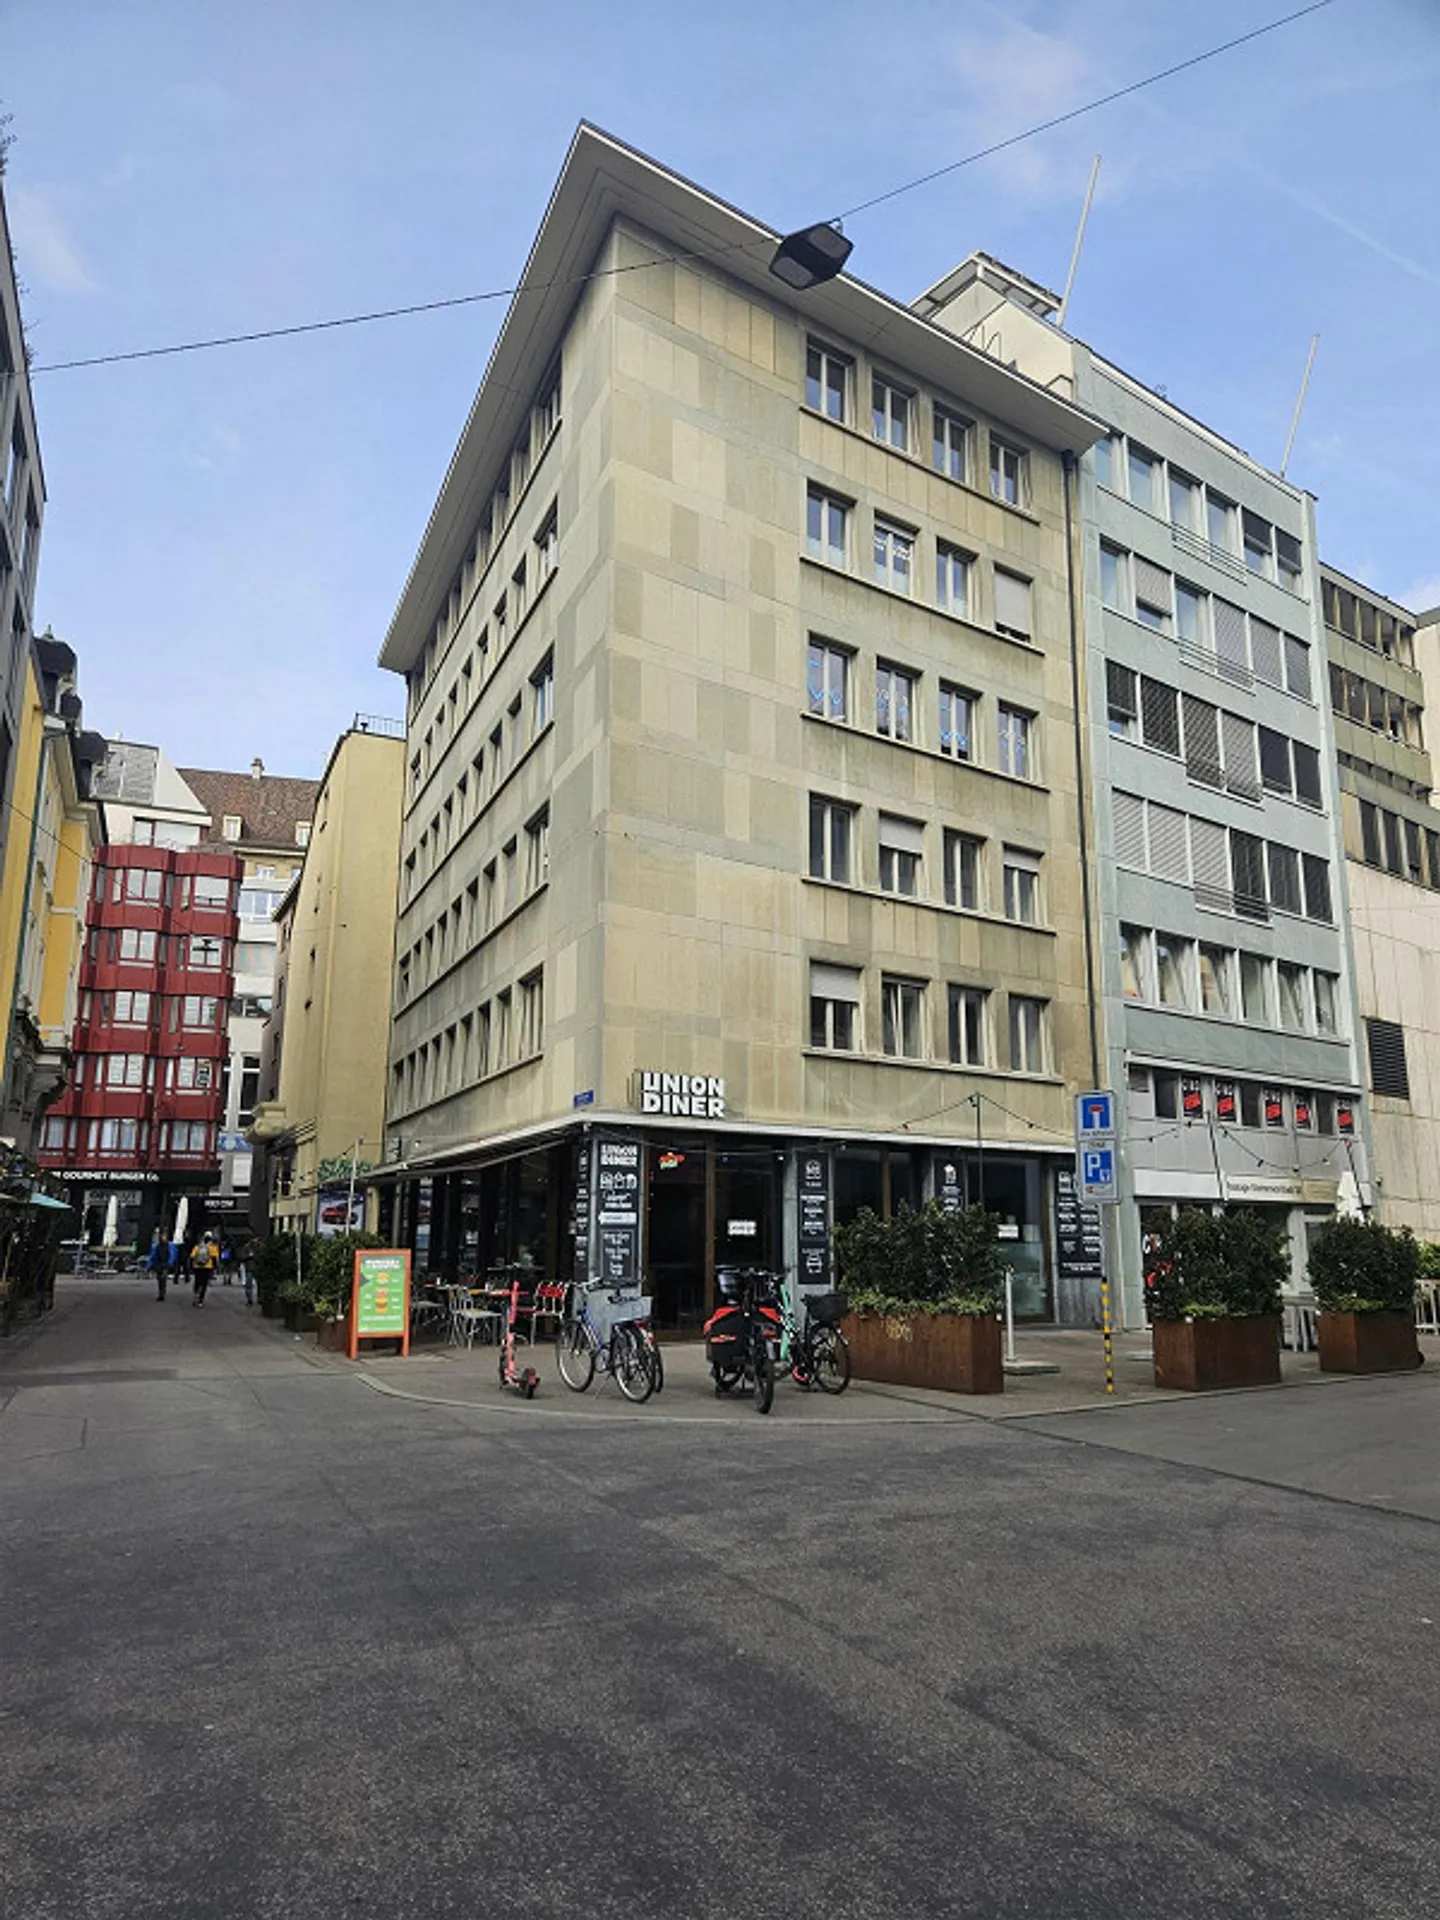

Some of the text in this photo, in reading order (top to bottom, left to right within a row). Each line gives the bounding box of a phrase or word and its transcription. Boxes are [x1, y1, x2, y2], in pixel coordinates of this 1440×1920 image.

[644, 1073, 725, 1097] UNION
[643, 1093, 725, 1118] DINER
[63, 1171, 108, 1180] GOURMET
[109, 1171, 145, 1181] BURGER
[1087, 1154, 1101, 1177] P
